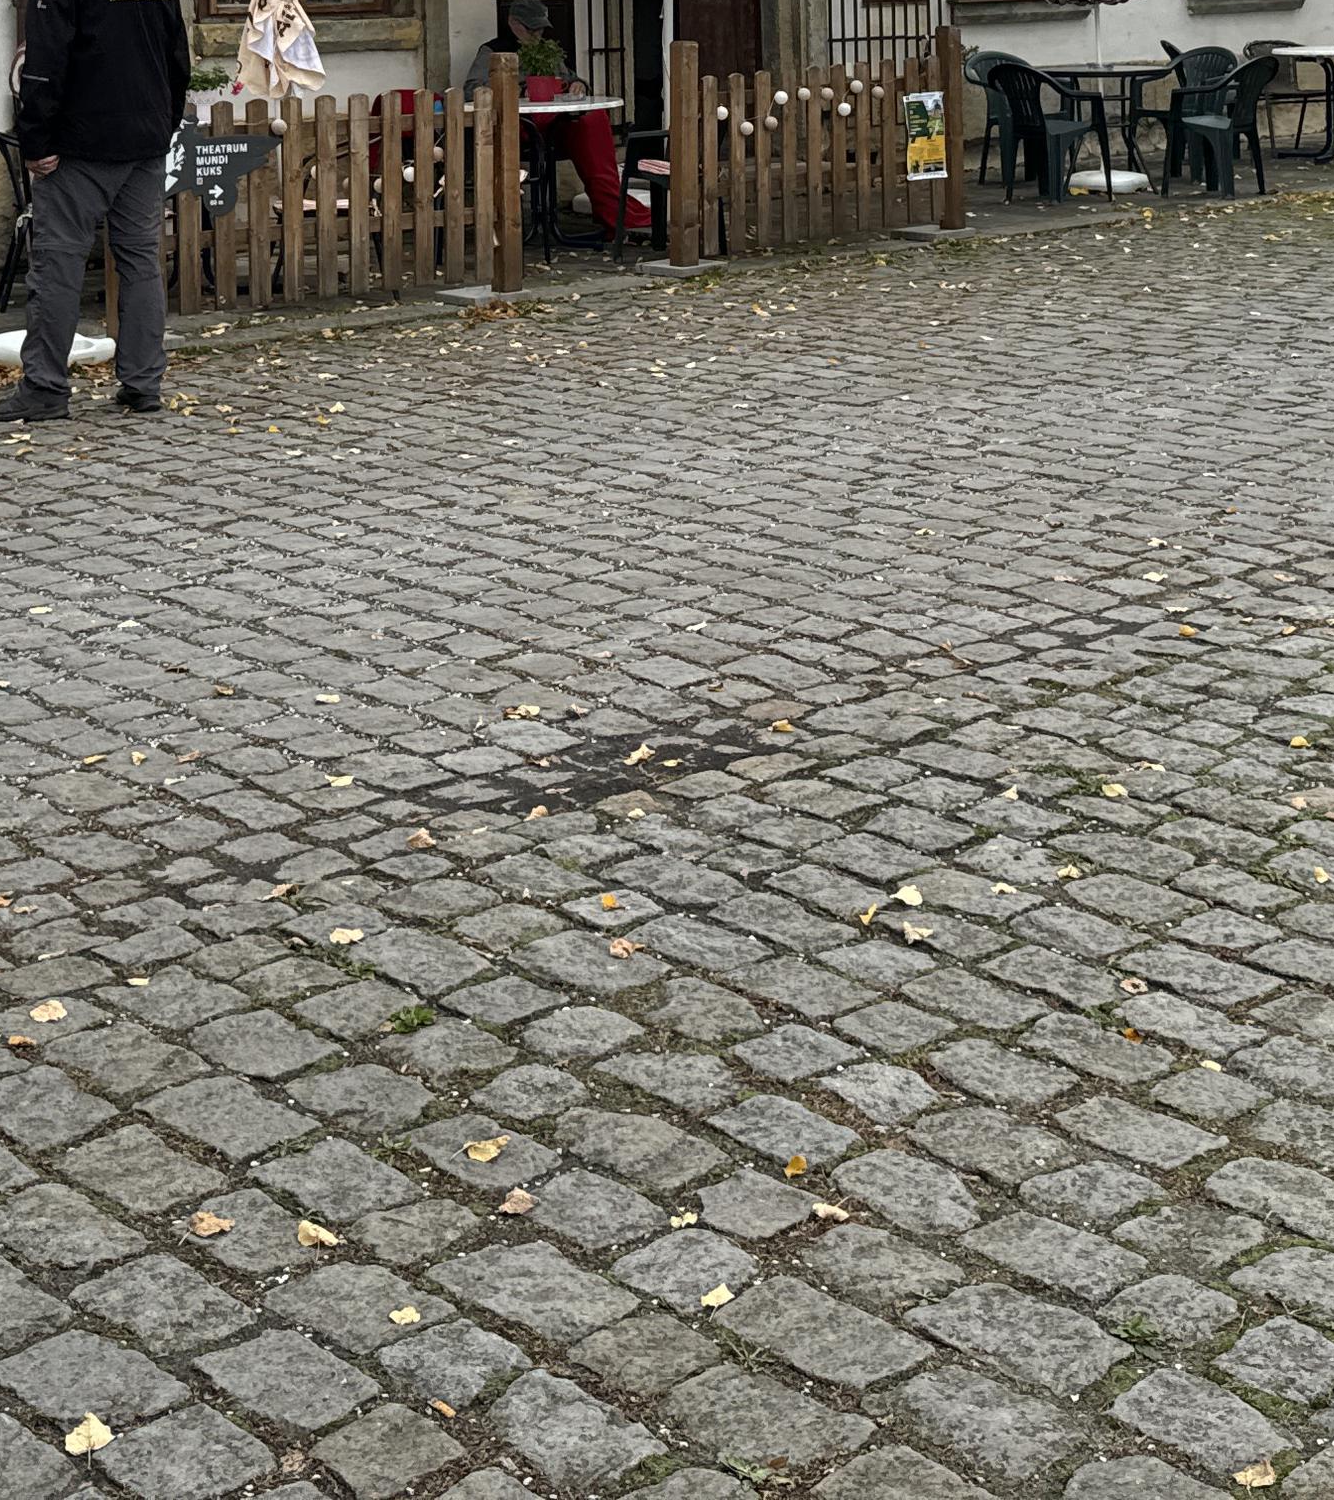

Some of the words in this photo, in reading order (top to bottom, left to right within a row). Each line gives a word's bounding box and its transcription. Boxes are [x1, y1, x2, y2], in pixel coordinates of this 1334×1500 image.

[195, 143, 248, 155] THEATRUM
[196, 155, 228, 166] MUNDI
[196, 166, 222, 176] KUKS
